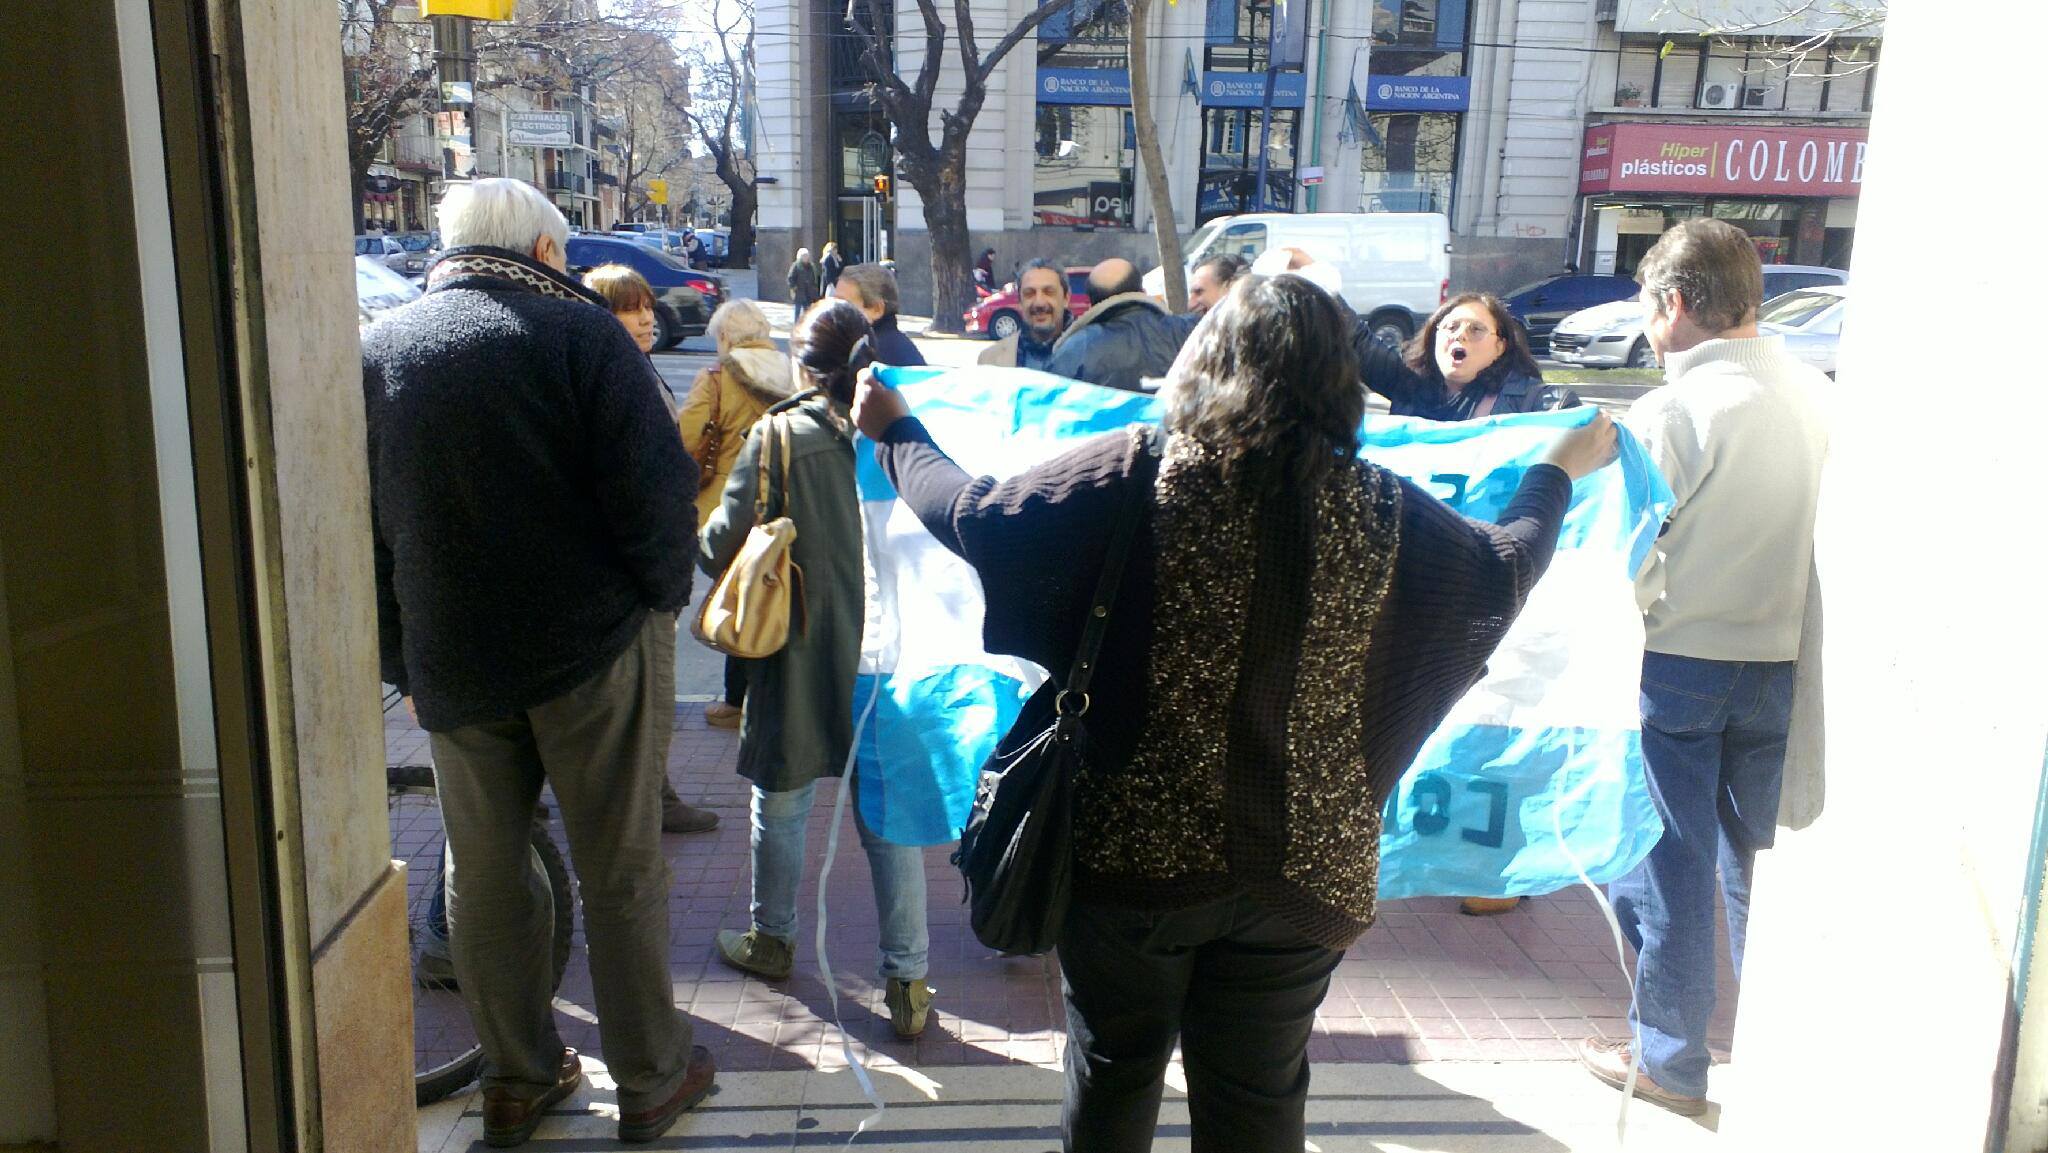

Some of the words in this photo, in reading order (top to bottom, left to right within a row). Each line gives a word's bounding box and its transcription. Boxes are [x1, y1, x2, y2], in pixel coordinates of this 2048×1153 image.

[1060, 78, 1087, 86] BANCO
[1091, 86, 1131, 94] ARGENTIN
[1422, 92, 1460, 100] ARGENTINA
[1621, 159, 1707, 178] plásticos
